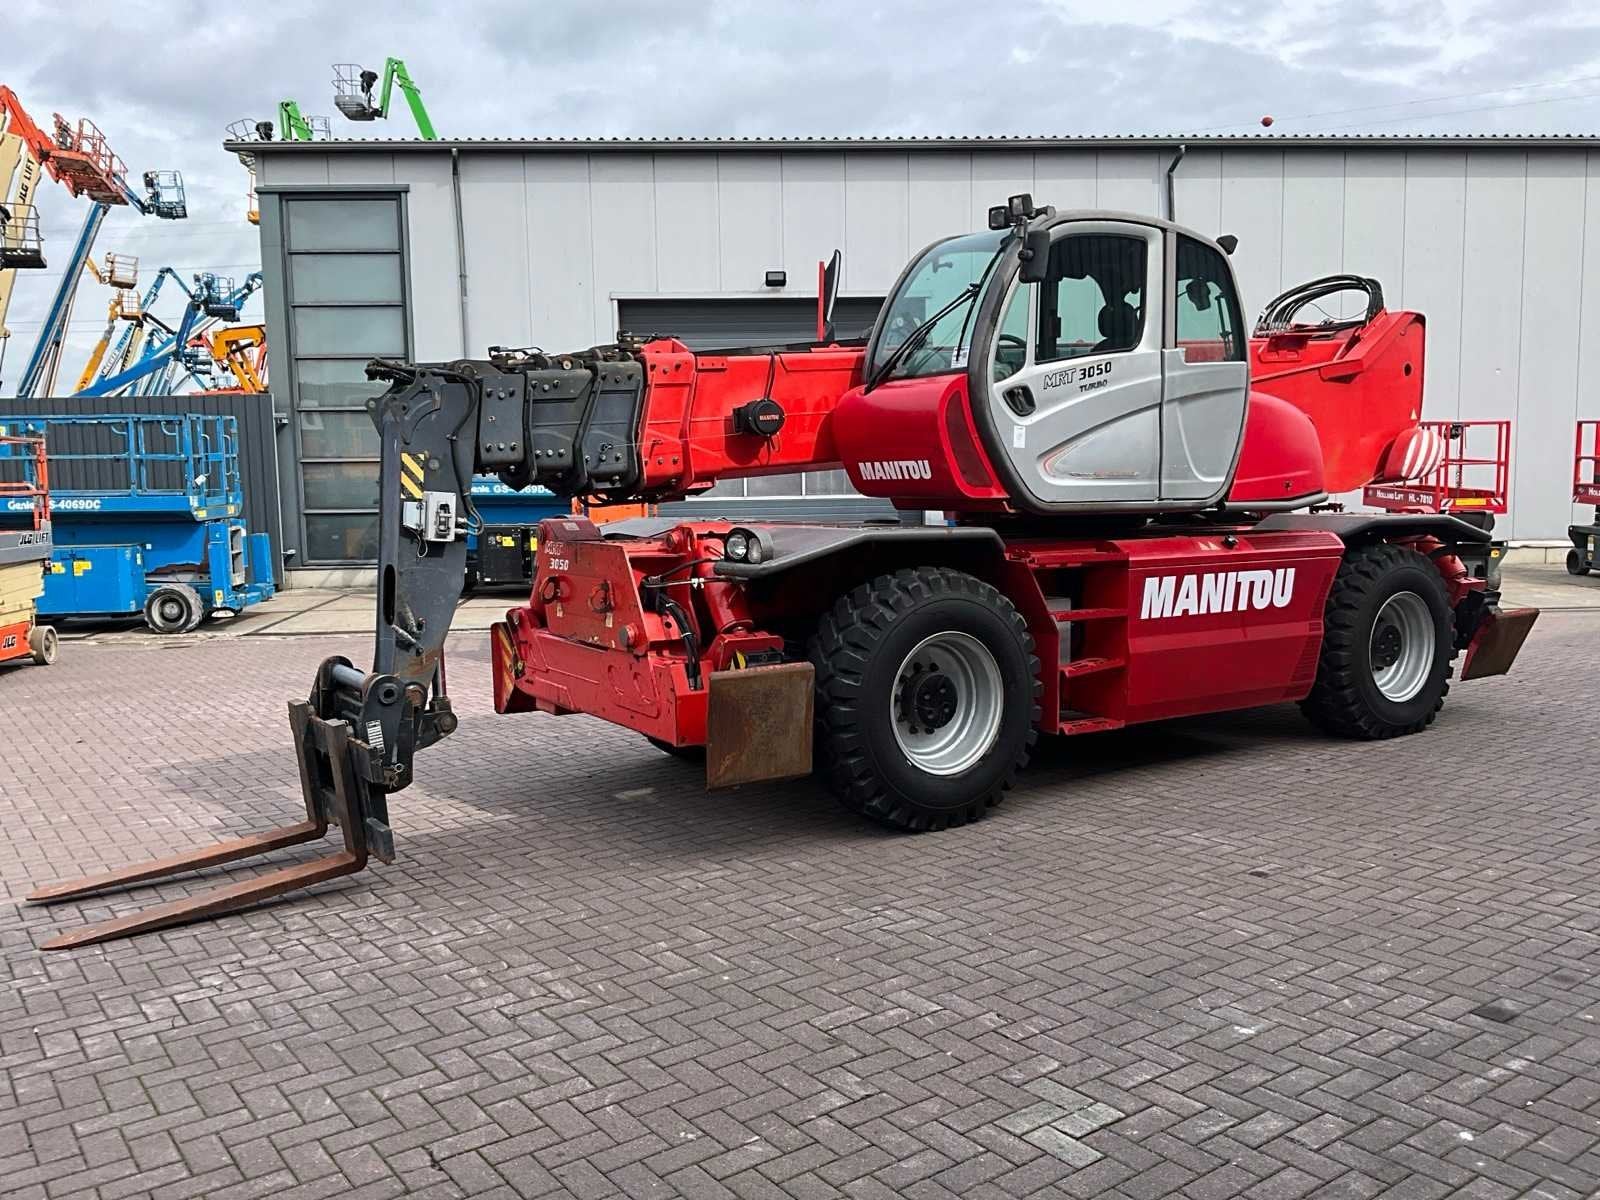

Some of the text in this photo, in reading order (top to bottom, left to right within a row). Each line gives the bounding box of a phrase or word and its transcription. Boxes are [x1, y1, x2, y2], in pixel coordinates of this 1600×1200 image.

[24, 158, 34, 180] LIFT
[1043, 361, 1112, 390] MRT 3050
[1079, 379, 1108, 392] TURBO
[858, 460, 932, 480] MANITOU
[48, 499, 101, 510] S-4069DC
[19, 532, 49, 545] JLG LIFT
[549, 557, 569, 571] 3050
[1140, 567, 1296, 620] MANITOU
